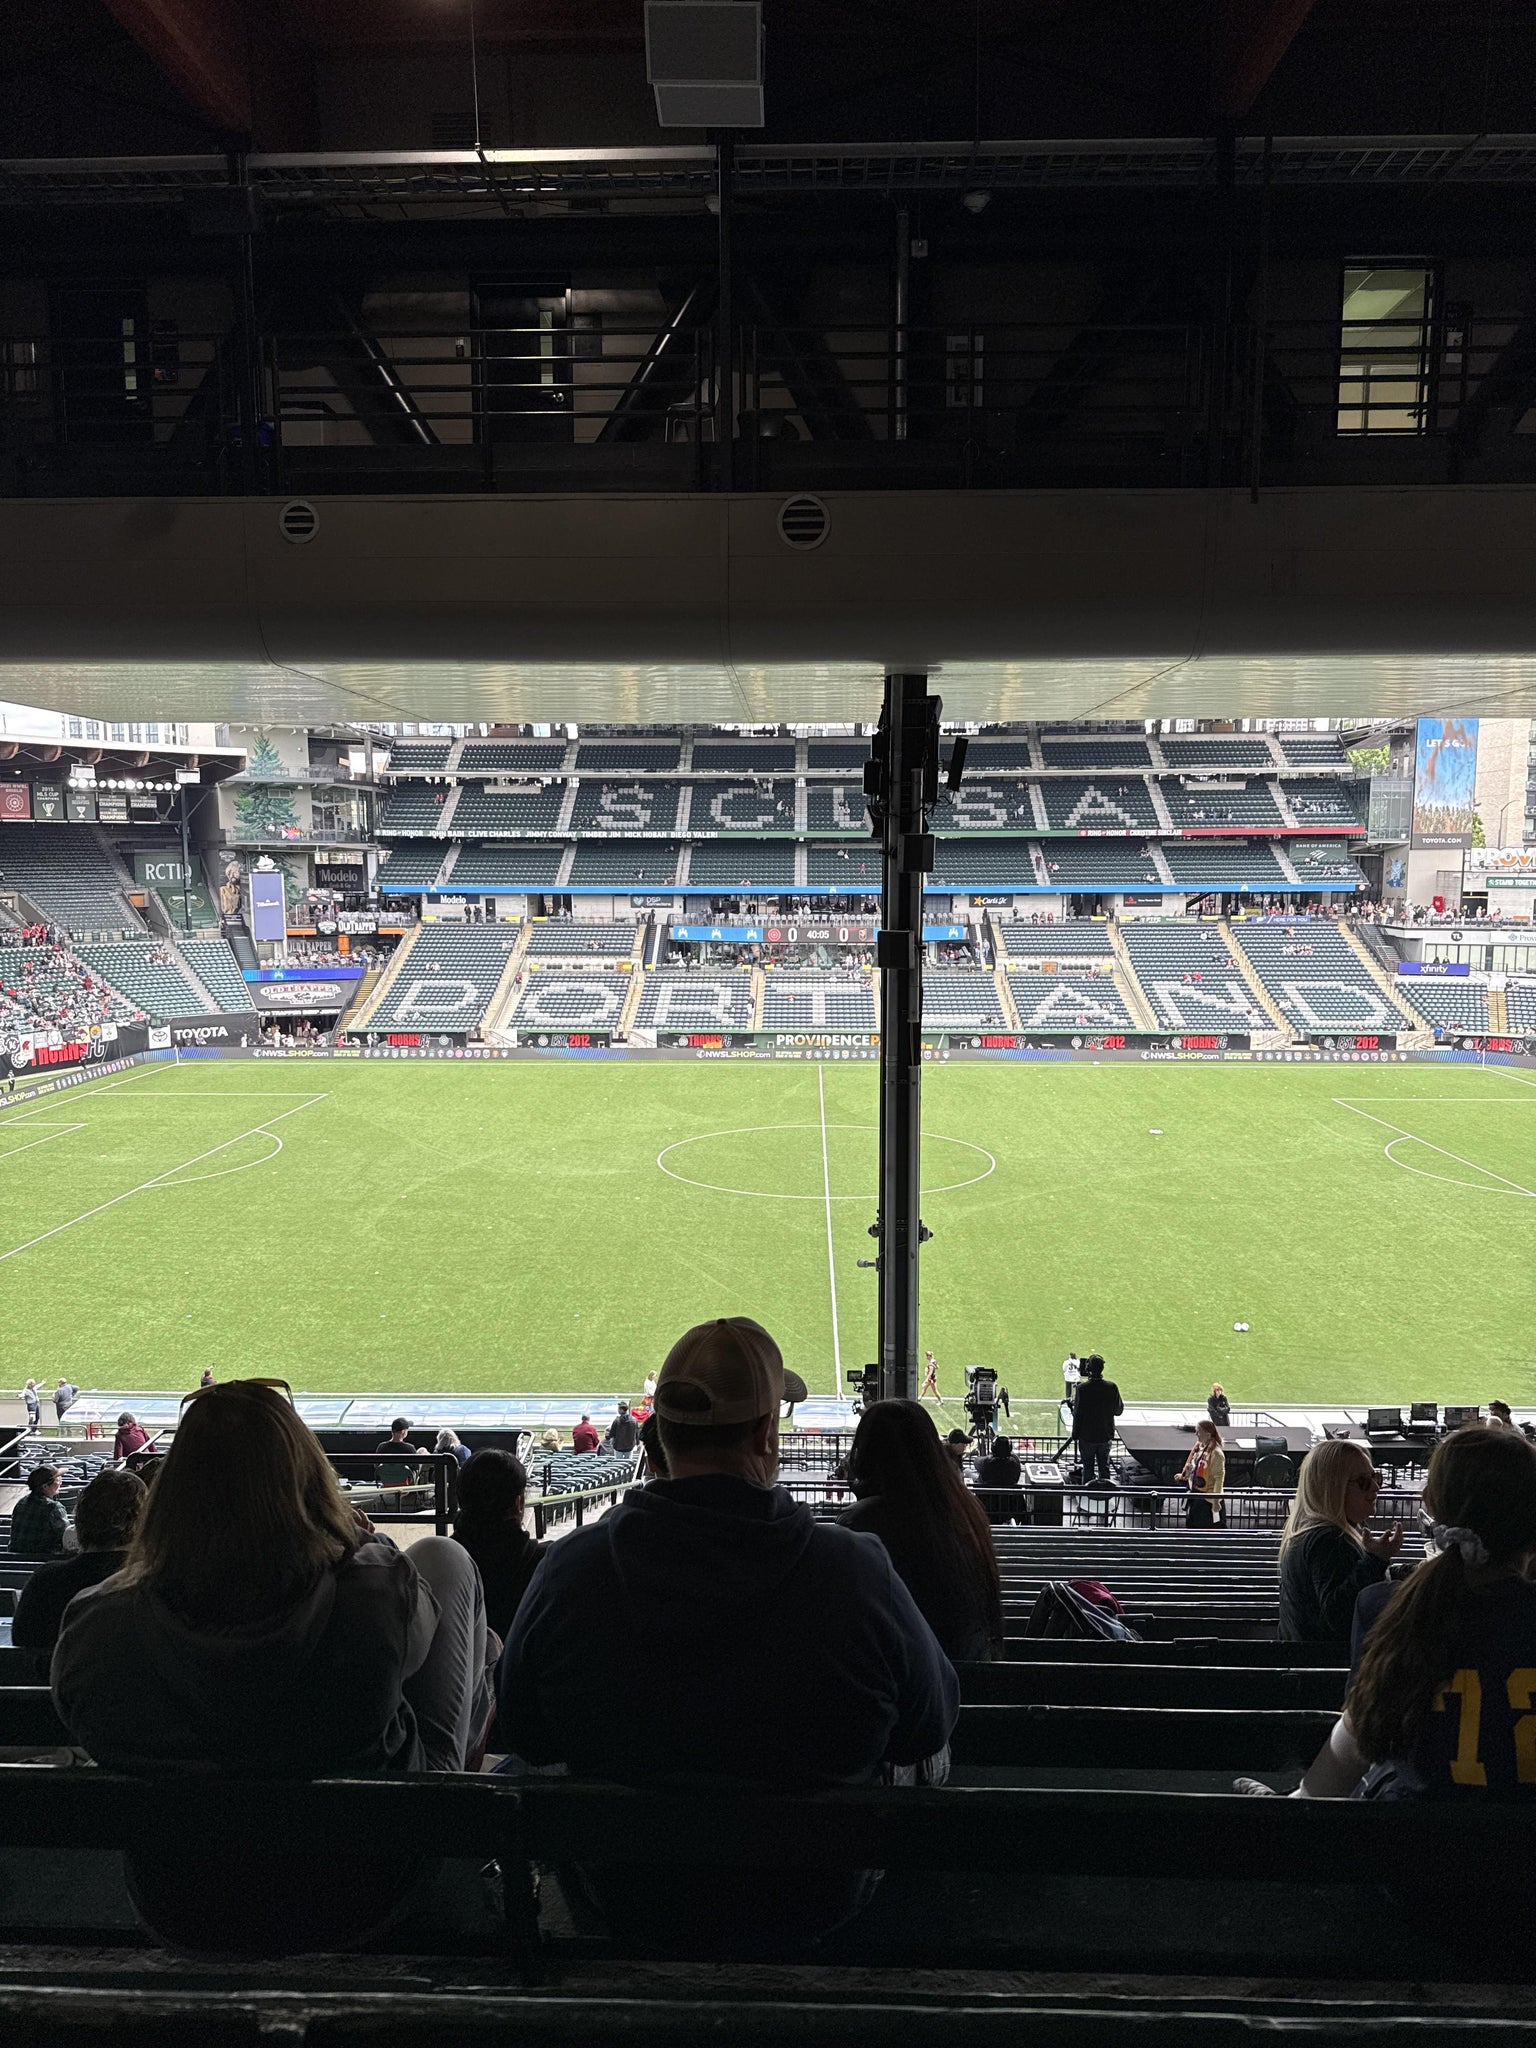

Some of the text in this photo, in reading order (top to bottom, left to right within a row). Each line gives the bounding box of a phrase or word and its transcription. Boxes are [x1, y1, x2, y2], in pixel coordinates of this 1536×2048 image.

[1426, 739, 1451, 748] LETS
[401, 830, 424, 838] HONOR
[468, 830, 488, 838] CLIVE
[489, 830, 521, 838] CHARLES
[525, 830, 547, 838] JIMMY
[548, 830, 577, 838] CONWAY
[581, 830, 607, 838] TIMBER
[608, 830, 621, 838] JIM
[624, 830, 642, 838] MICK
[643, 830, 667, 838] HOBAN
[670, 830, 692, 838] DIEGO
[693, 830, 719, 838] VALERI
[1087, 829, 1183, 837] RING HONOR CHRISTINE SINCLAIR
[320, 868, 358, 882] Modelo
[440, 894, 467, 906] Modelo
[337, 920, 350, 932] OLD
[350, 920, 377, 931] TRAPPER
[787, 926, 849, 943] 0 40:05 0
[1420, 964, 1448, 974] xfinity
[262, 983, 341, 996] OLD TRAPPER
[173, 1025, 229, 1042] TOYOTA
[385, 1034, 420, 1048] THORNS
[569, 1034, 591, 1047] 2012
[688, 1034, 733, 1048] THORNS FC
[776, 1034, 871, 1047] PROVIDENCE
[981, 1034, 1015, 1048] THORNS
[1103, 1035, 1126, 1049] 2012
[1181, 1035, 1228, 1050] THORNS FC
[1356, 1035, 1379, 1050] 2012
[1473, 1037, 1512, 1052] TORNS
[262, 1049, 329, 1057] NWSLSHOP.com
[705, 1050, 771, 1059] NWSLSHOP.com
[1150, 1051, 1220, 1060] NWSLSHOP.com
